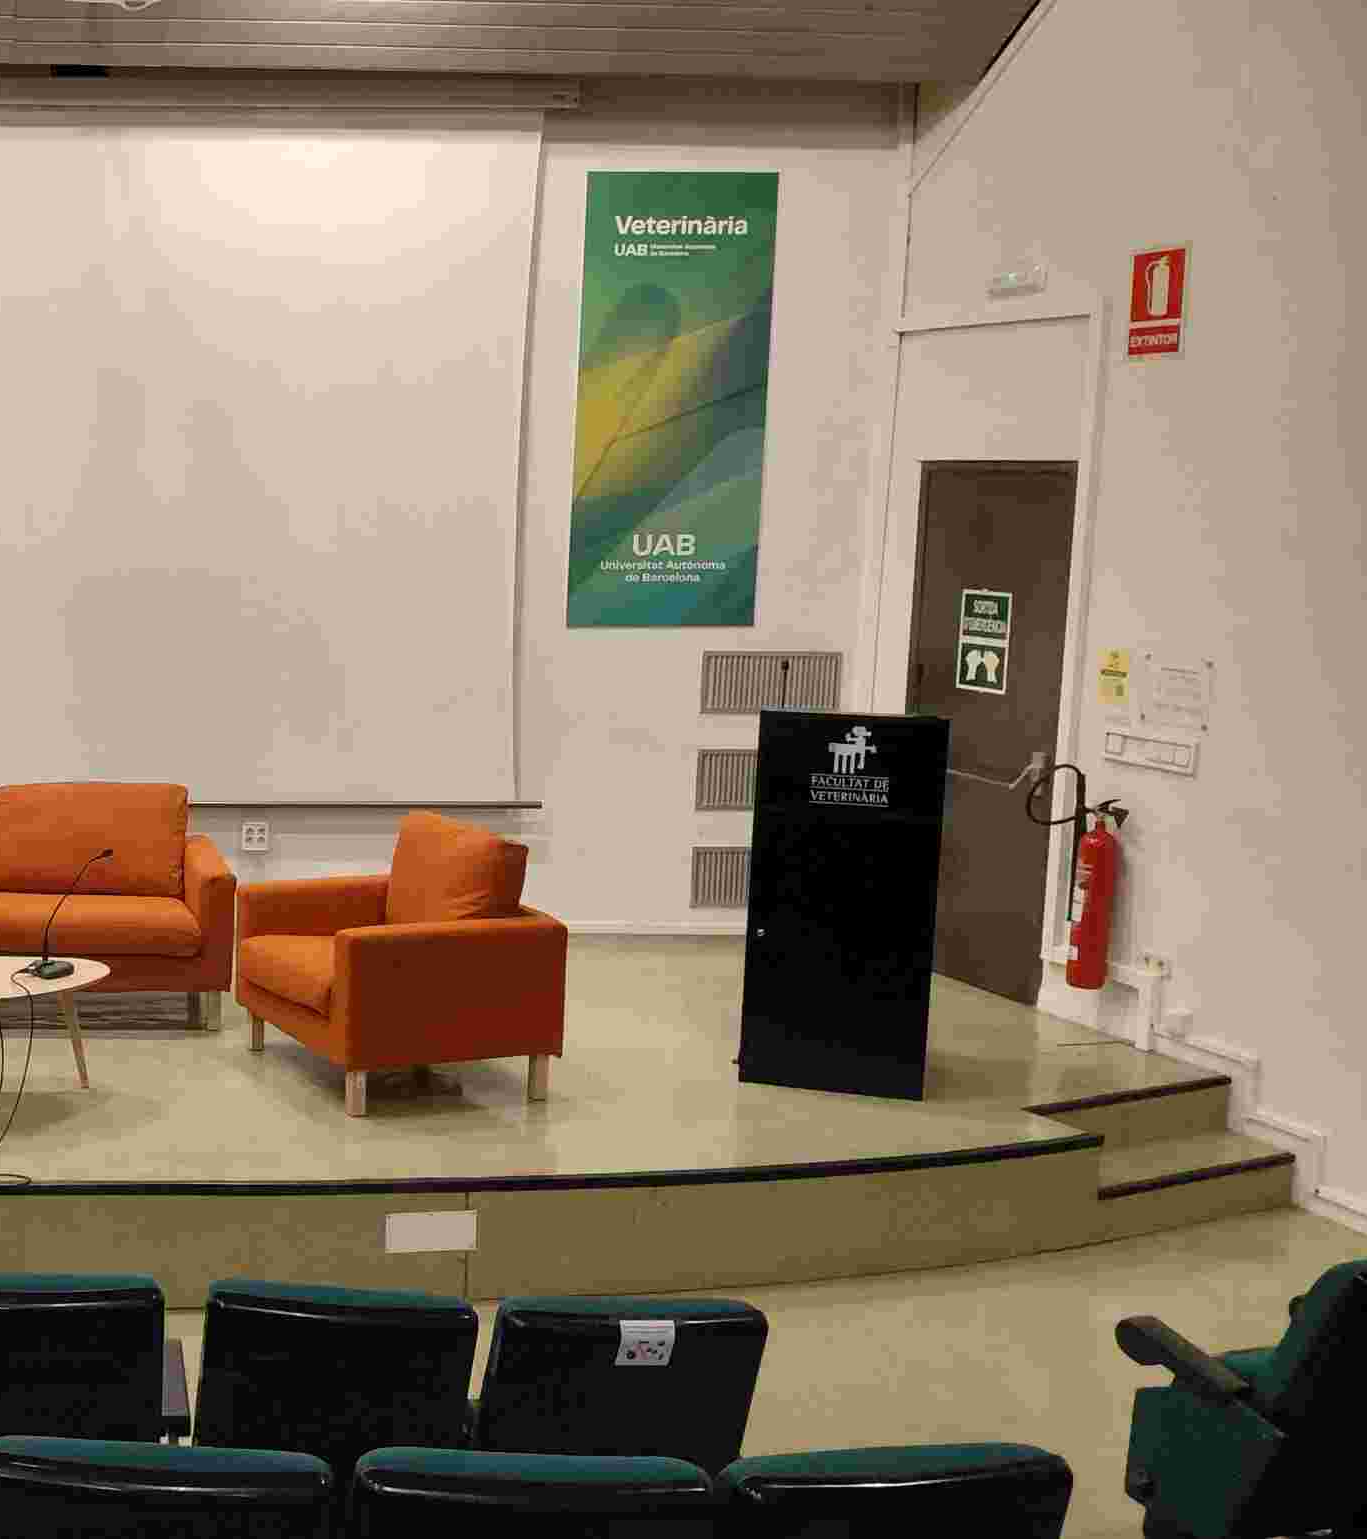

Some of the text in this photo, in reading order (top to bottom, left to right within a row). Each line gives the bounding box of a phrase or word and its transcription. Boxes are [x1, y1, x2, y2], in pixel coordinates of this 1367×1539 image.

[614, 215, 749, 235] Veterinària
[614, 243, 649, 257] UAB
[632, 533, 697, 557] UAB
[600, 559, 664, 571] Universitat
[624, 572, 701, 583] de Barcelona
[810, 775, 890, 792] FACULTAT DE
